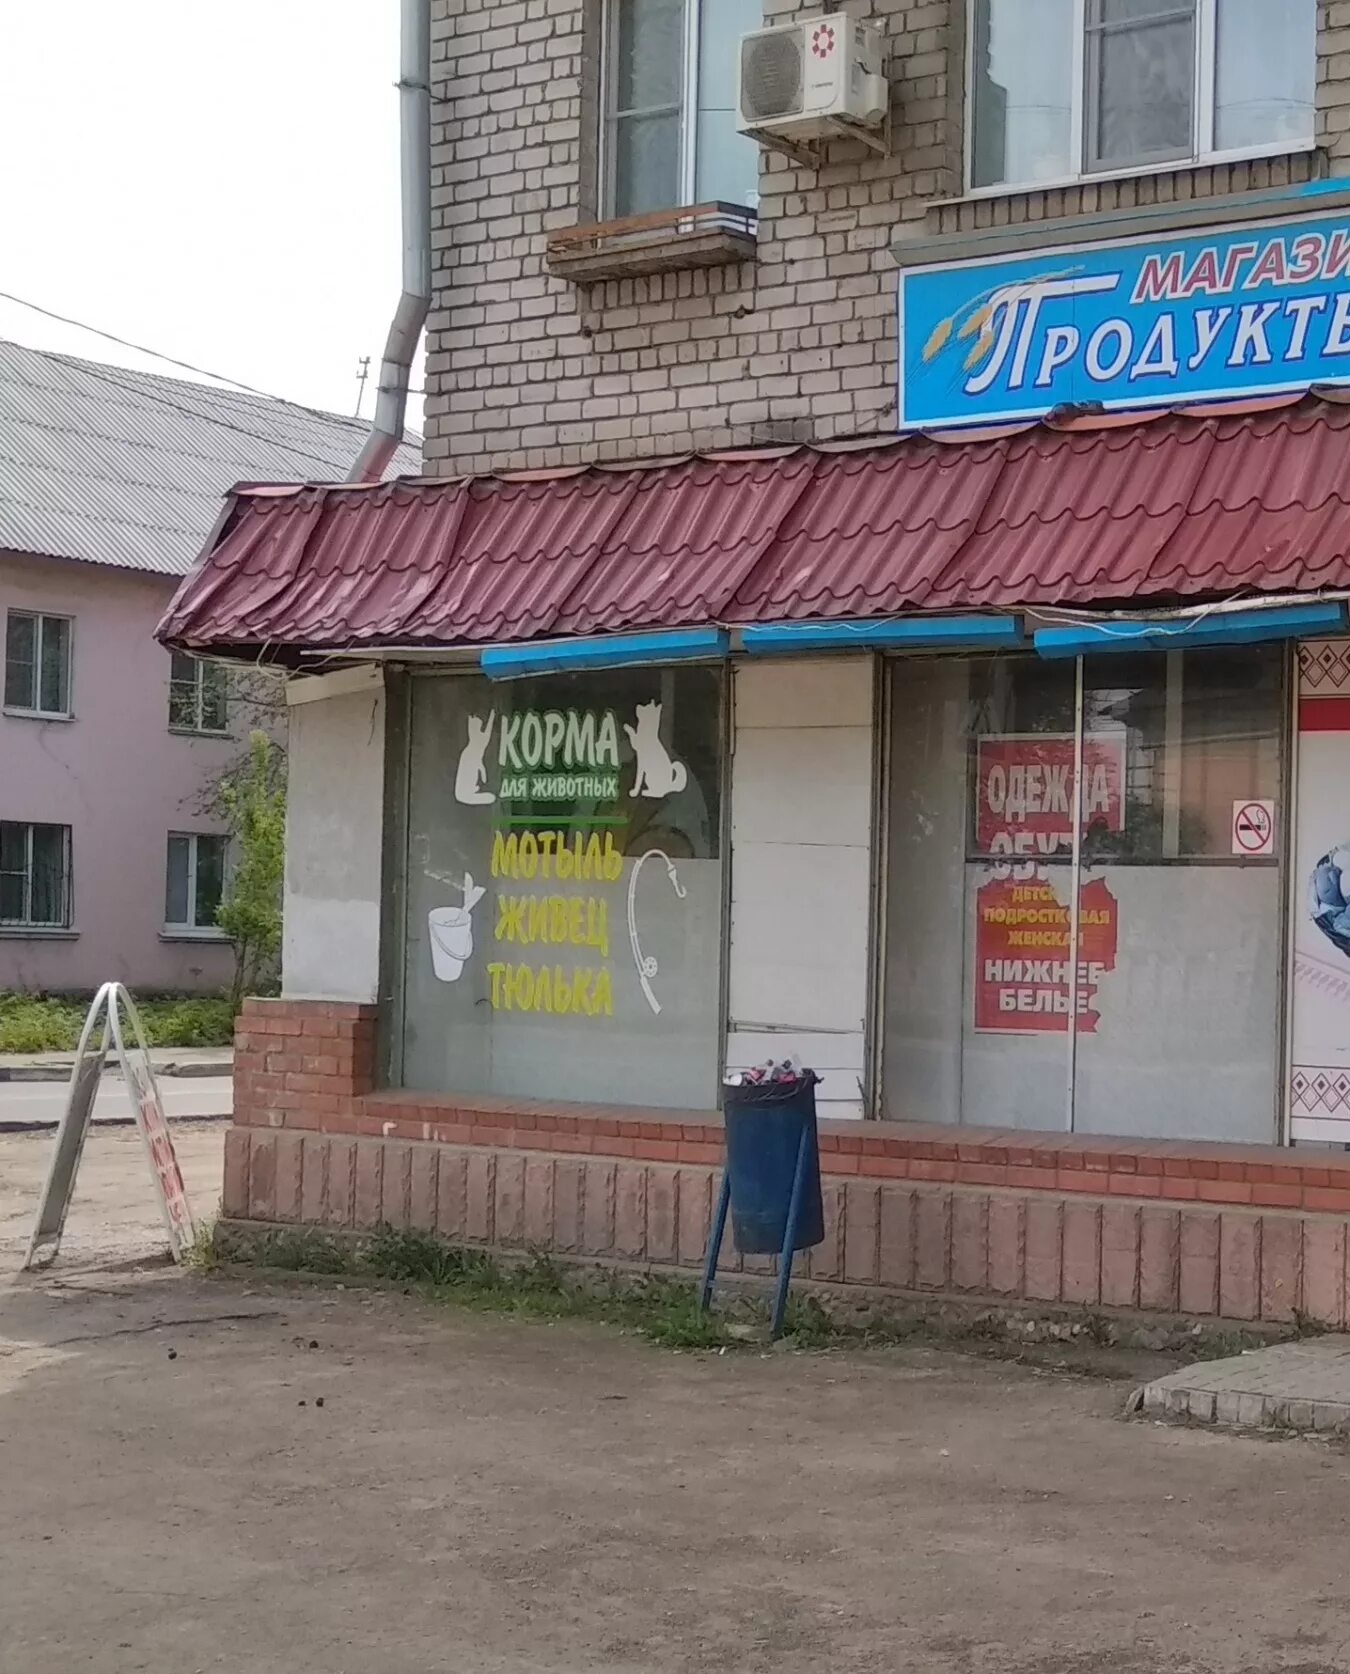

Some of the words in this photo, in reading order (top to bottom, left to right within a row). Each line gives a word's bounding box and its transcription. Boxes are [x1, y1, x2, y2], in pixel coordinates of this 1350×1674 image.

[499, 711, 619, 769] КОРМА
[531, 775, 618, 798] ЖИВОТНЫХ
[987, 764, 1109, 823] ОДЕЖДА
[491, 830, 624, 880] МОТЫЛЬ
[494, 894, 609, 958] ЖИВЕЦ
[983, 907, 1110, 925] ПОДРОСТКВАЯ
[487, 962, 612, 1016] ТЮЛЬКА
